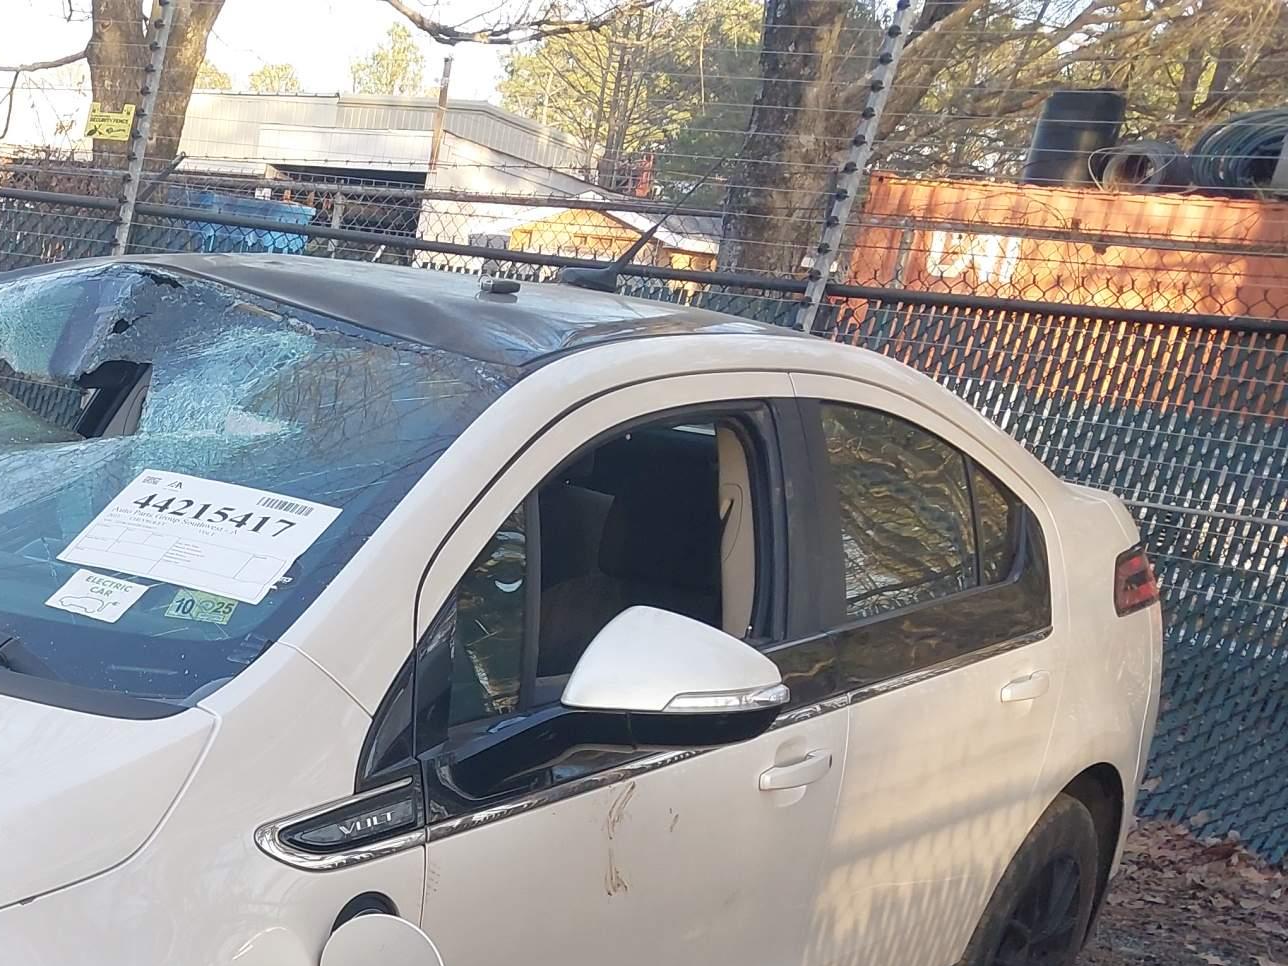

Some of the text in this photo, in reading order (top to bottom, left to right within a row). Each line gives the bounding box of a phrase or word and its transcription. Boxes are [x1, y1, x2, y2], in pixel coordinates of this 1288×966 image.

[112, 506, 133, 515] Auto
[134, 509, 153, 518] Parts
[155, 513, 181, 524] Group
[183, 519, 224, 532] Southwest
[133, 493, 297, 537] 44215417
[86, 575, 133, 592] ELECTRIC
[90, 586, 113, 597] CAR
[175, 597, 235, 615] 10 25
